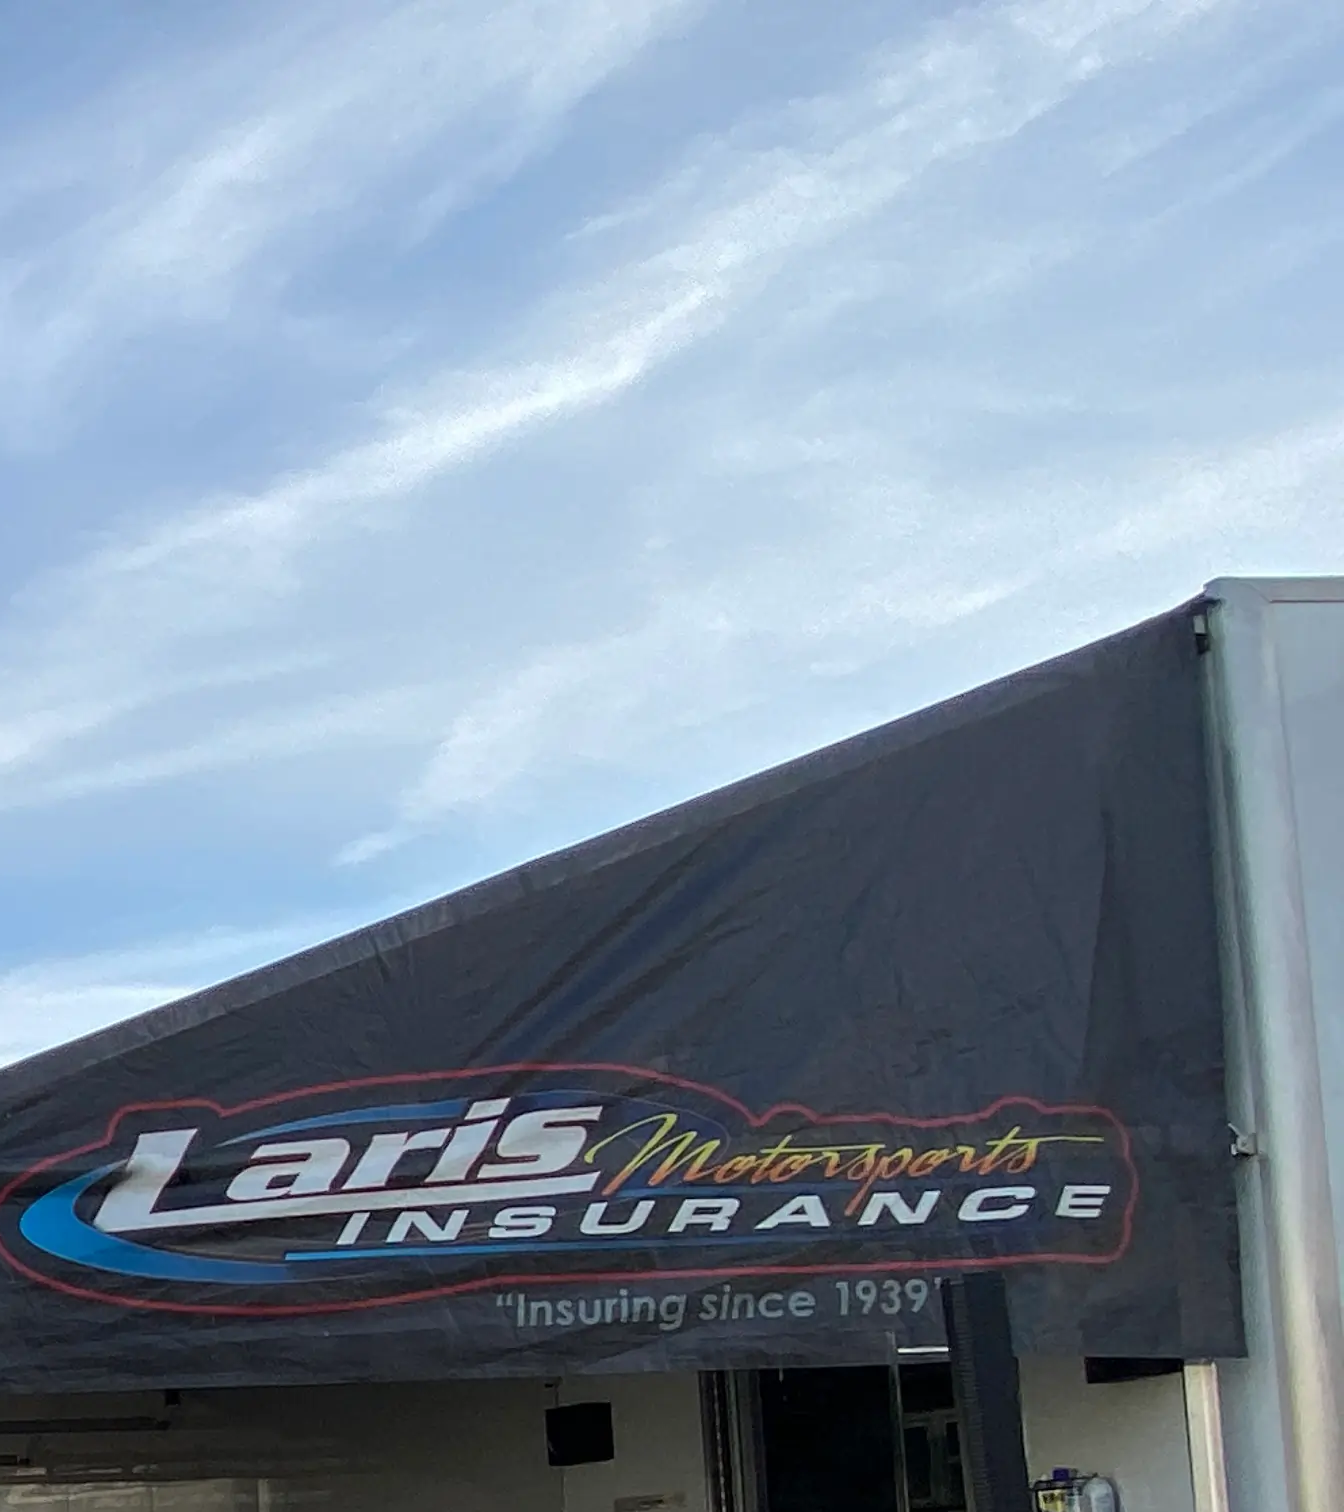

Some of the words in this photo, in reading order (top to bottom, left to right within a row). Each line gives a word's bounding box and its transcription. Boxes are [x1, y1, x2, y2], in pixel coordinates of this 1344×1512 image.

[93, 1097, 602, 1233] Laris
[585, 1113, 1105, 1217] Motorsports
[336, 1184, 1111, 1246] INSURANCE
[496, 1287, 688, 1331] "Insuring
[698, 1284, 816, 1320] since
